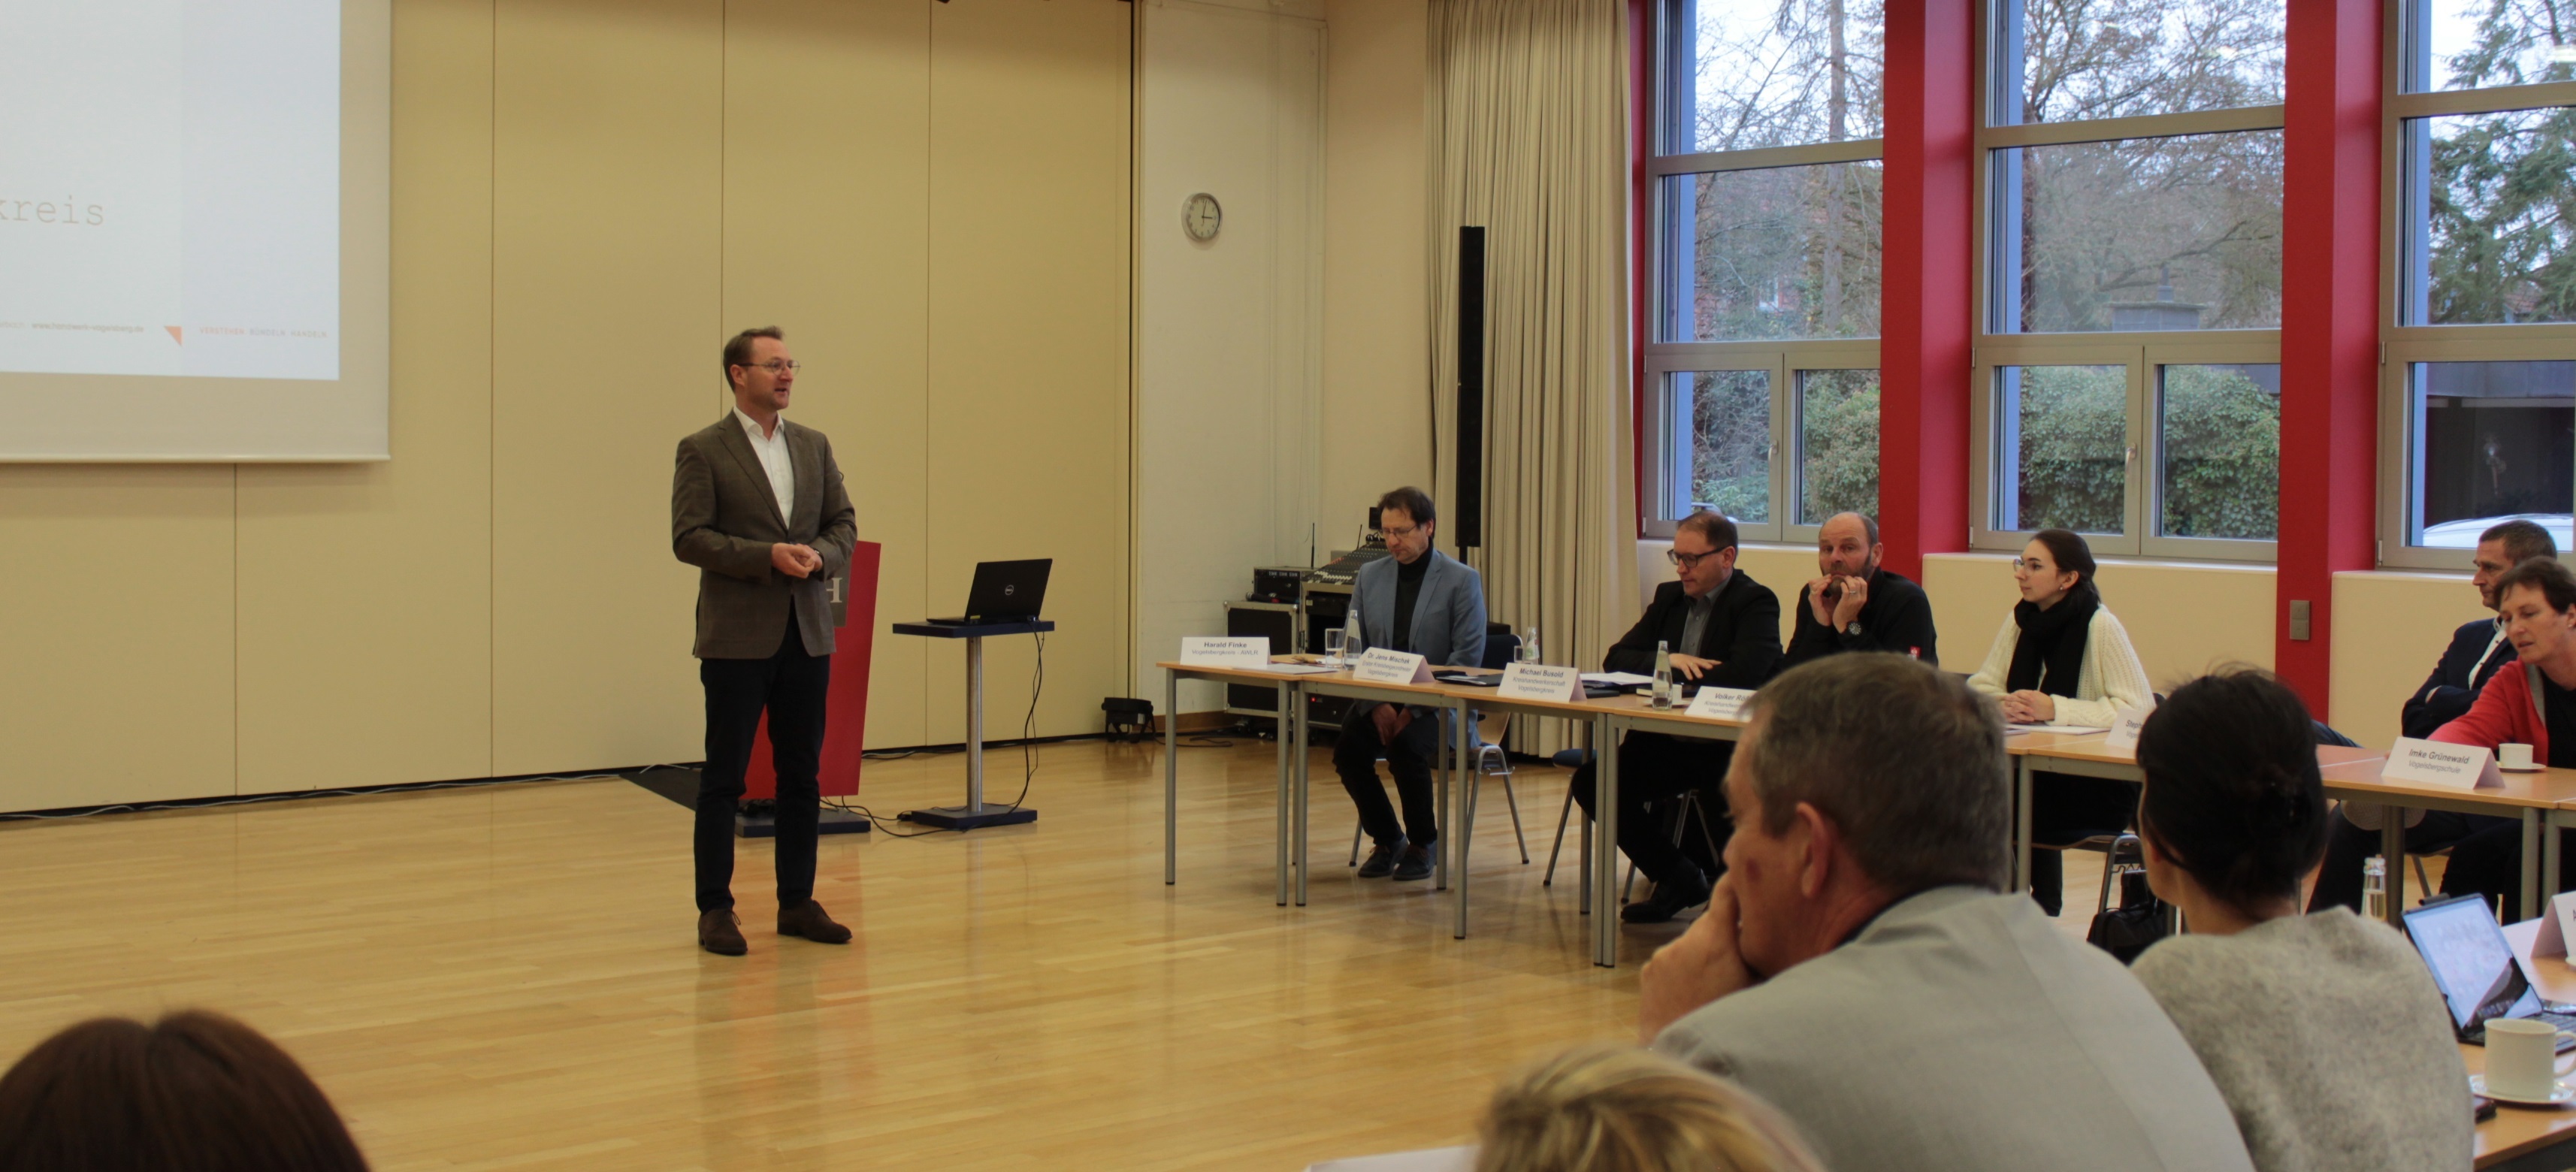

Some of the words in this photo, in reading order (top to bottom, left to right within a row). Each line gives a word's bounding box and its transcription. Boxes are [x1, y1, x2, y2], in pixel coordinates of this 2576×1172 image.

[1519, 667, 1542, 676] Michael
[1543, 669, 1565, 678] Busold
[1714, 693, 1735, 701] Volker
[2408, 748, 2427, 758] Imke
[2428, 751, 2470, 764] Grünewald
[2408, 760, 2461, 774] Vogelsbergschule
